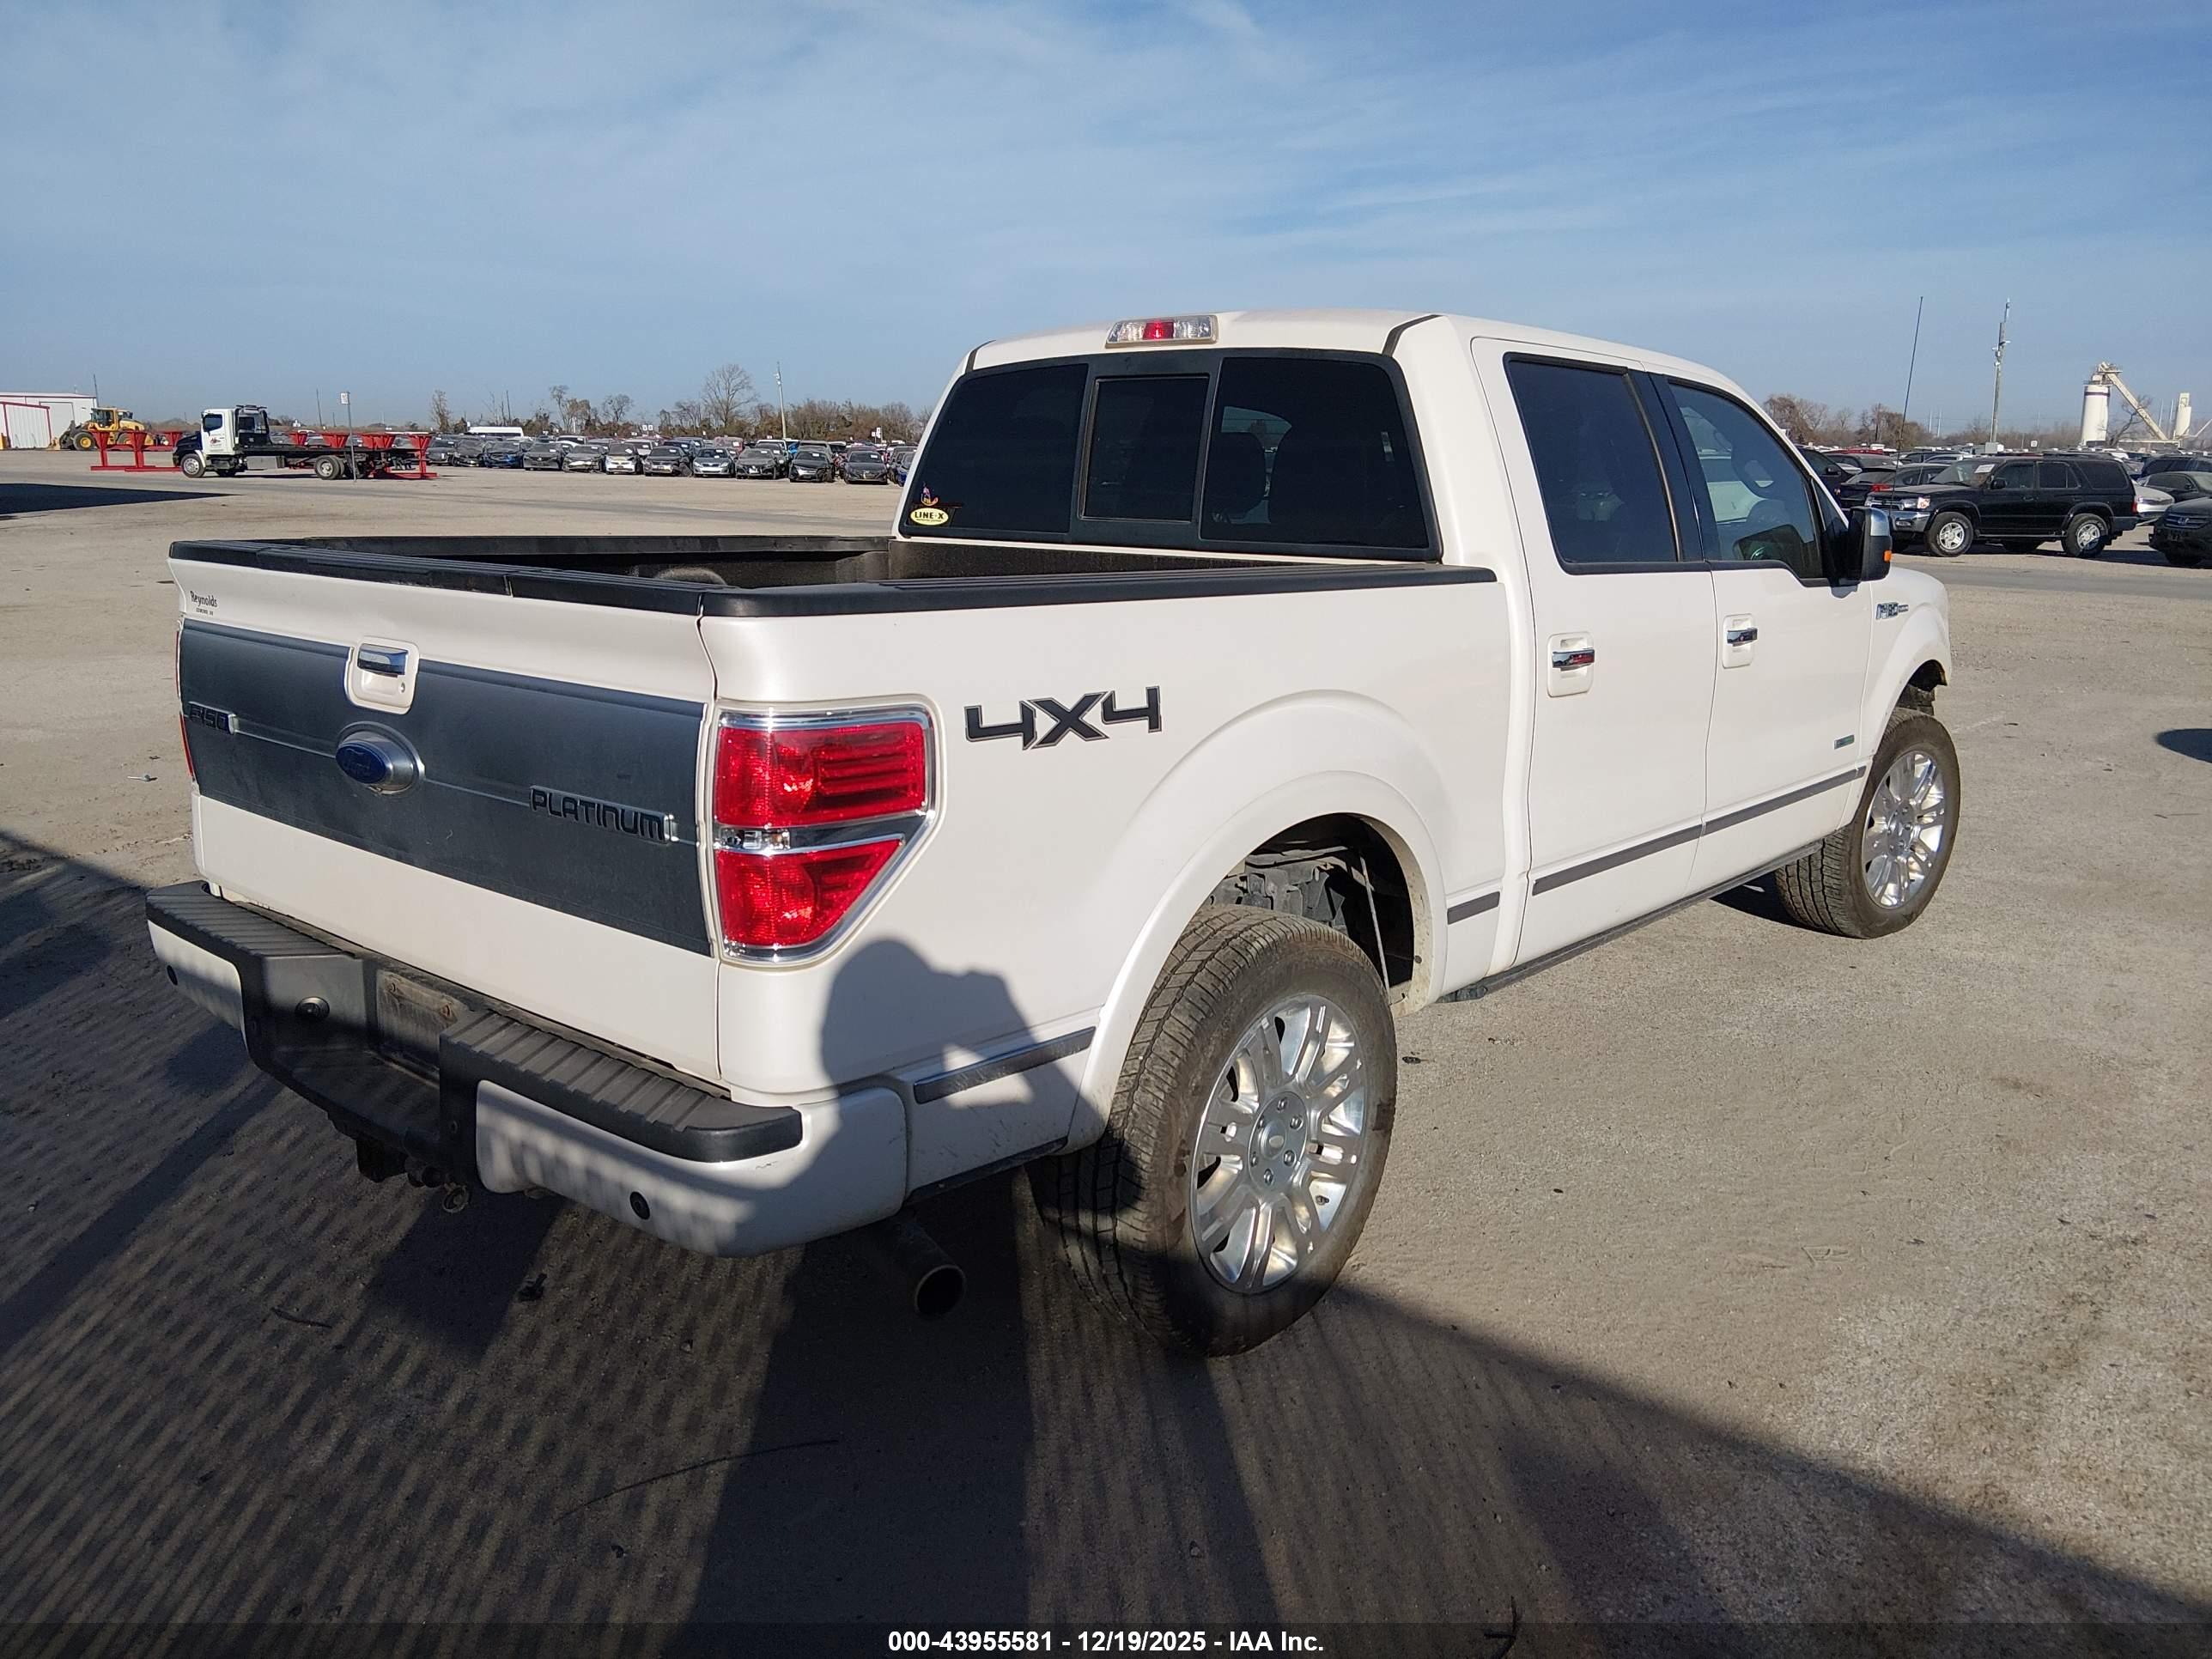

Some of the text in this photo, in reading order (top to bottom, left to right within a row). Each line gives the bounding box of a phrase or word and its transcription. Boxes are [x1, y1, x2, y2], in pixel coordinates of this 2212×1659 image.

[915, 511, 945, 520] LINE-X
[190, 590, 218, 608] Reynolds
[964, 685, 1162, 750] 4X4
[530, 787, 666, 842] PLATINUM
